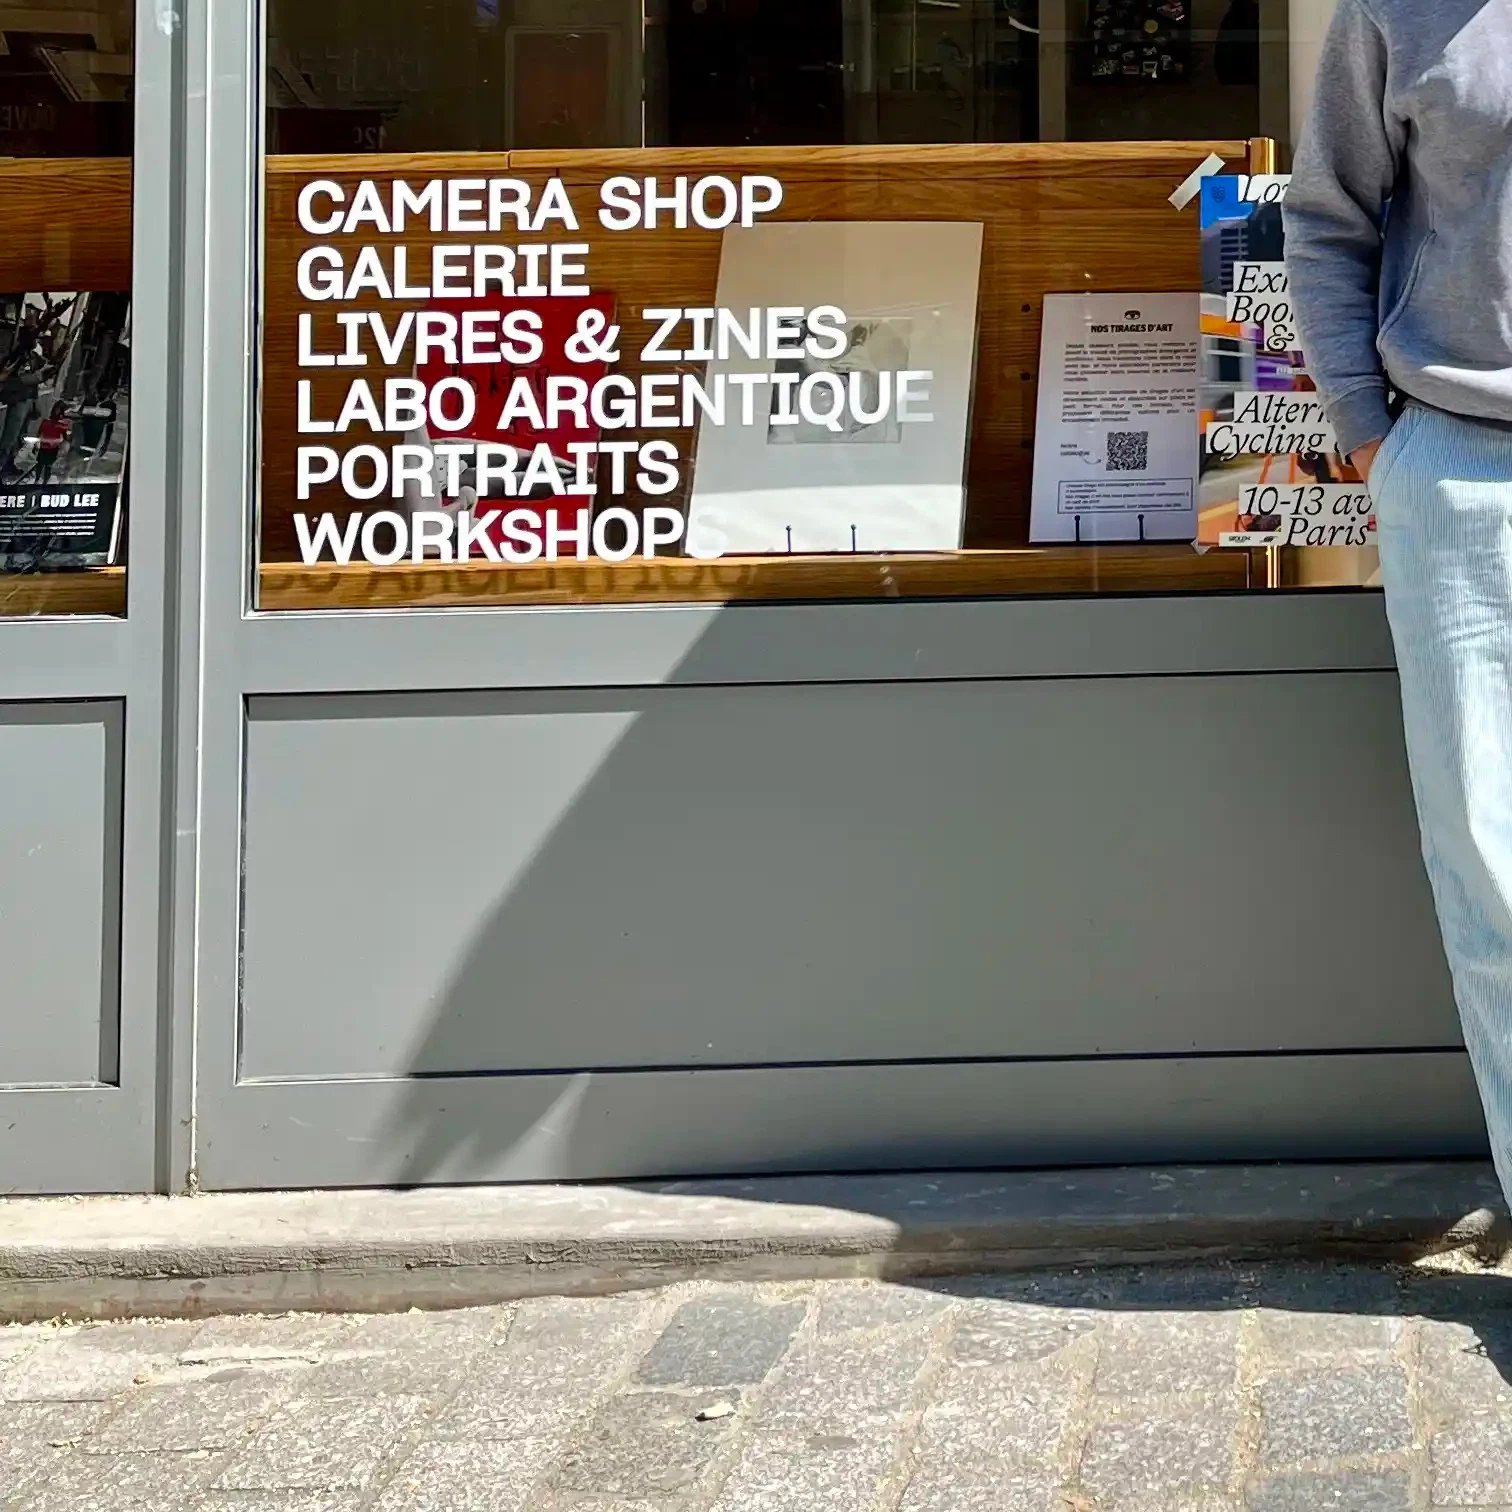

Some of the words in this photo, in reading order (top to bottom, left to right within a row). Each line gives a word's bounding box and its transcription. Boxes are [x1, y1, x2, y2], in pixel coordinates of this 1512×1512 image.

[297, 178, 580, 235] CAMERA
[598, 175, 783, 230] SHOP
[1240, 175, 1289, 203] Lo
[297, 243, 590, 301] GALERIE
[1227, 295, 1294, 324] Boo
[298, 309, 544, 367] LIVRES
[564, 308, 621, 363] &
[640, 305, 848, 362] ZINES
[1091, 325, 1109, 334] NOS
[1111, 324, 1147, 333] TIRAGES
[1147, 323, 1173, 333] D'ART
[1266, 324, 1295, 352] &
[297, 376, 476, 433] LABO
[496, 370, 934, 432] ARGENTIQUE
[1210, 424, 1327, 462] Cycling
[297, 440, 680, 500] PORTRAITS
[40, 494, 70, 508] BUD
[73, 493, 100, 507] LEE
[1244, 485, 1325, 516] 10-13
[294, 506, 728, 565] WORKSHOPS
[1286, 517, 1370, 546] Paris
